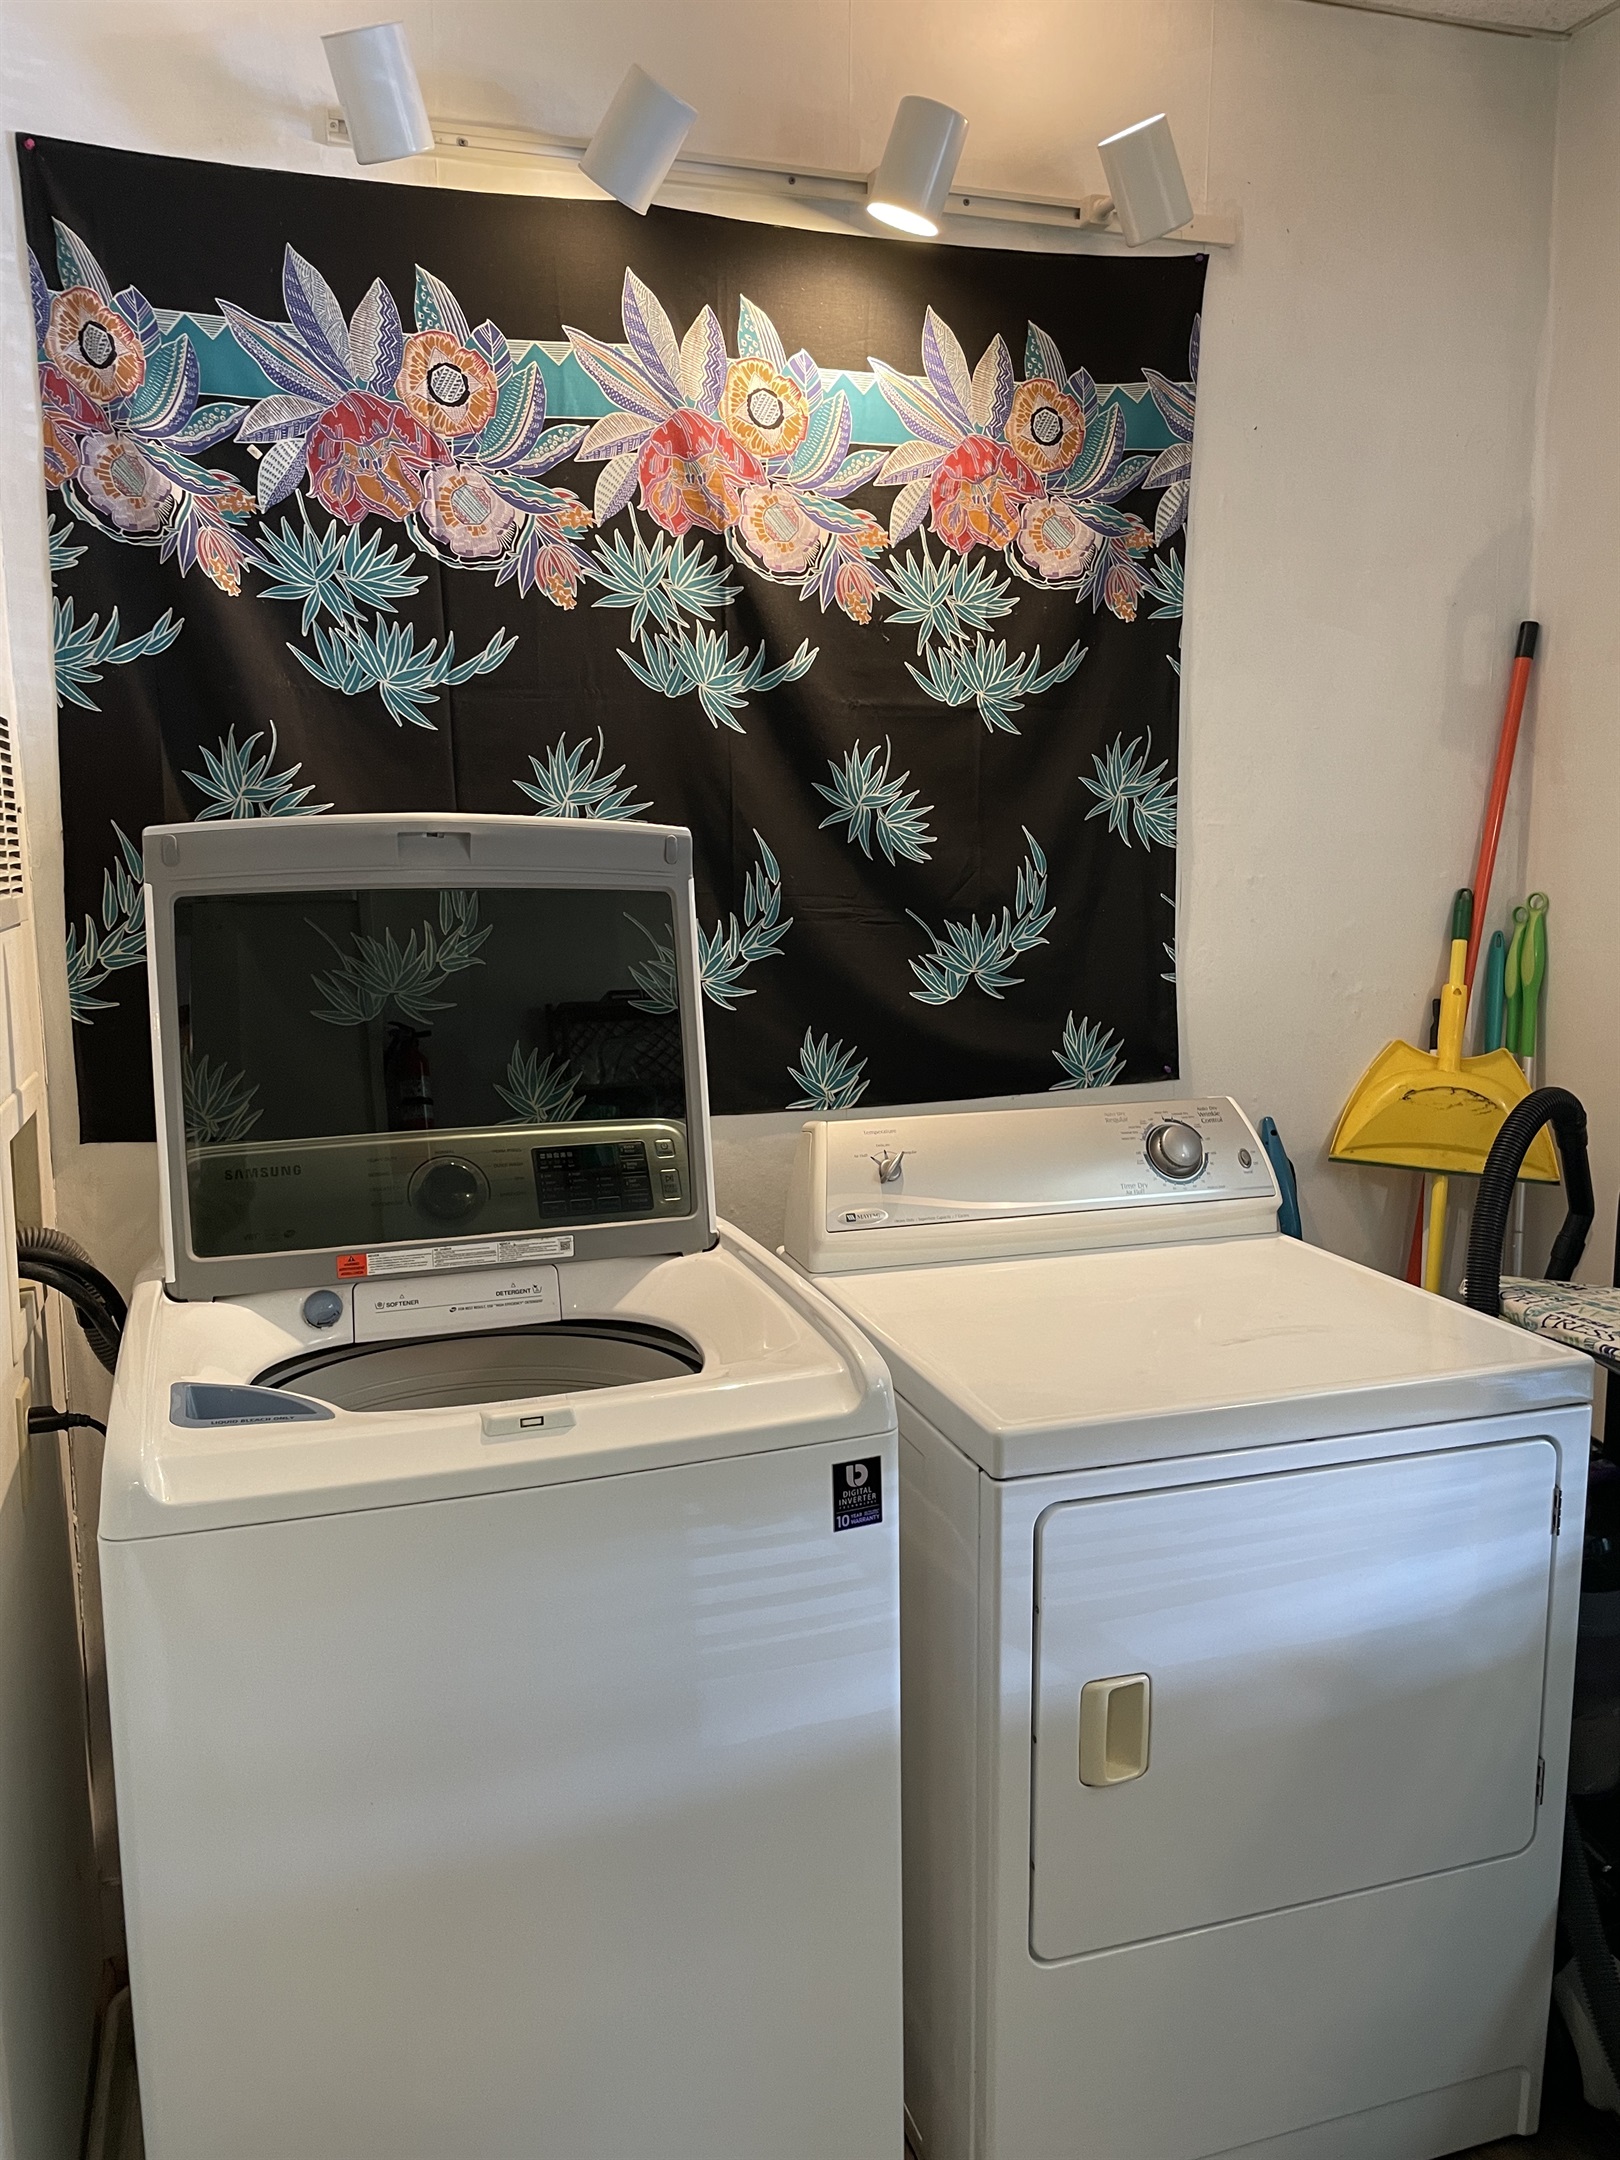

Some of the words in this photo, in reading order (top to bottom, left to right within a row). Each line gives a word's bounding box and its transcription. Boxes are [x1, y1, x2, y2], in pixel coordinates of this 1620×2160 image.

[224, 1164, 302, 1181] SAMSUNG
[495, 1287, 531, 1297] DETERGENT
[386, 1299, 419, 1309] SOFTENER
[1540, 1313, 1615, 1341] PRESS
[843, 1487, 872, 1498] DIGITAL
[839, 1493, 877, 1506] INVERTER
[837, 1514, 850, 1528] 10
[851, 1514, 880, 1524] WARRANTY
